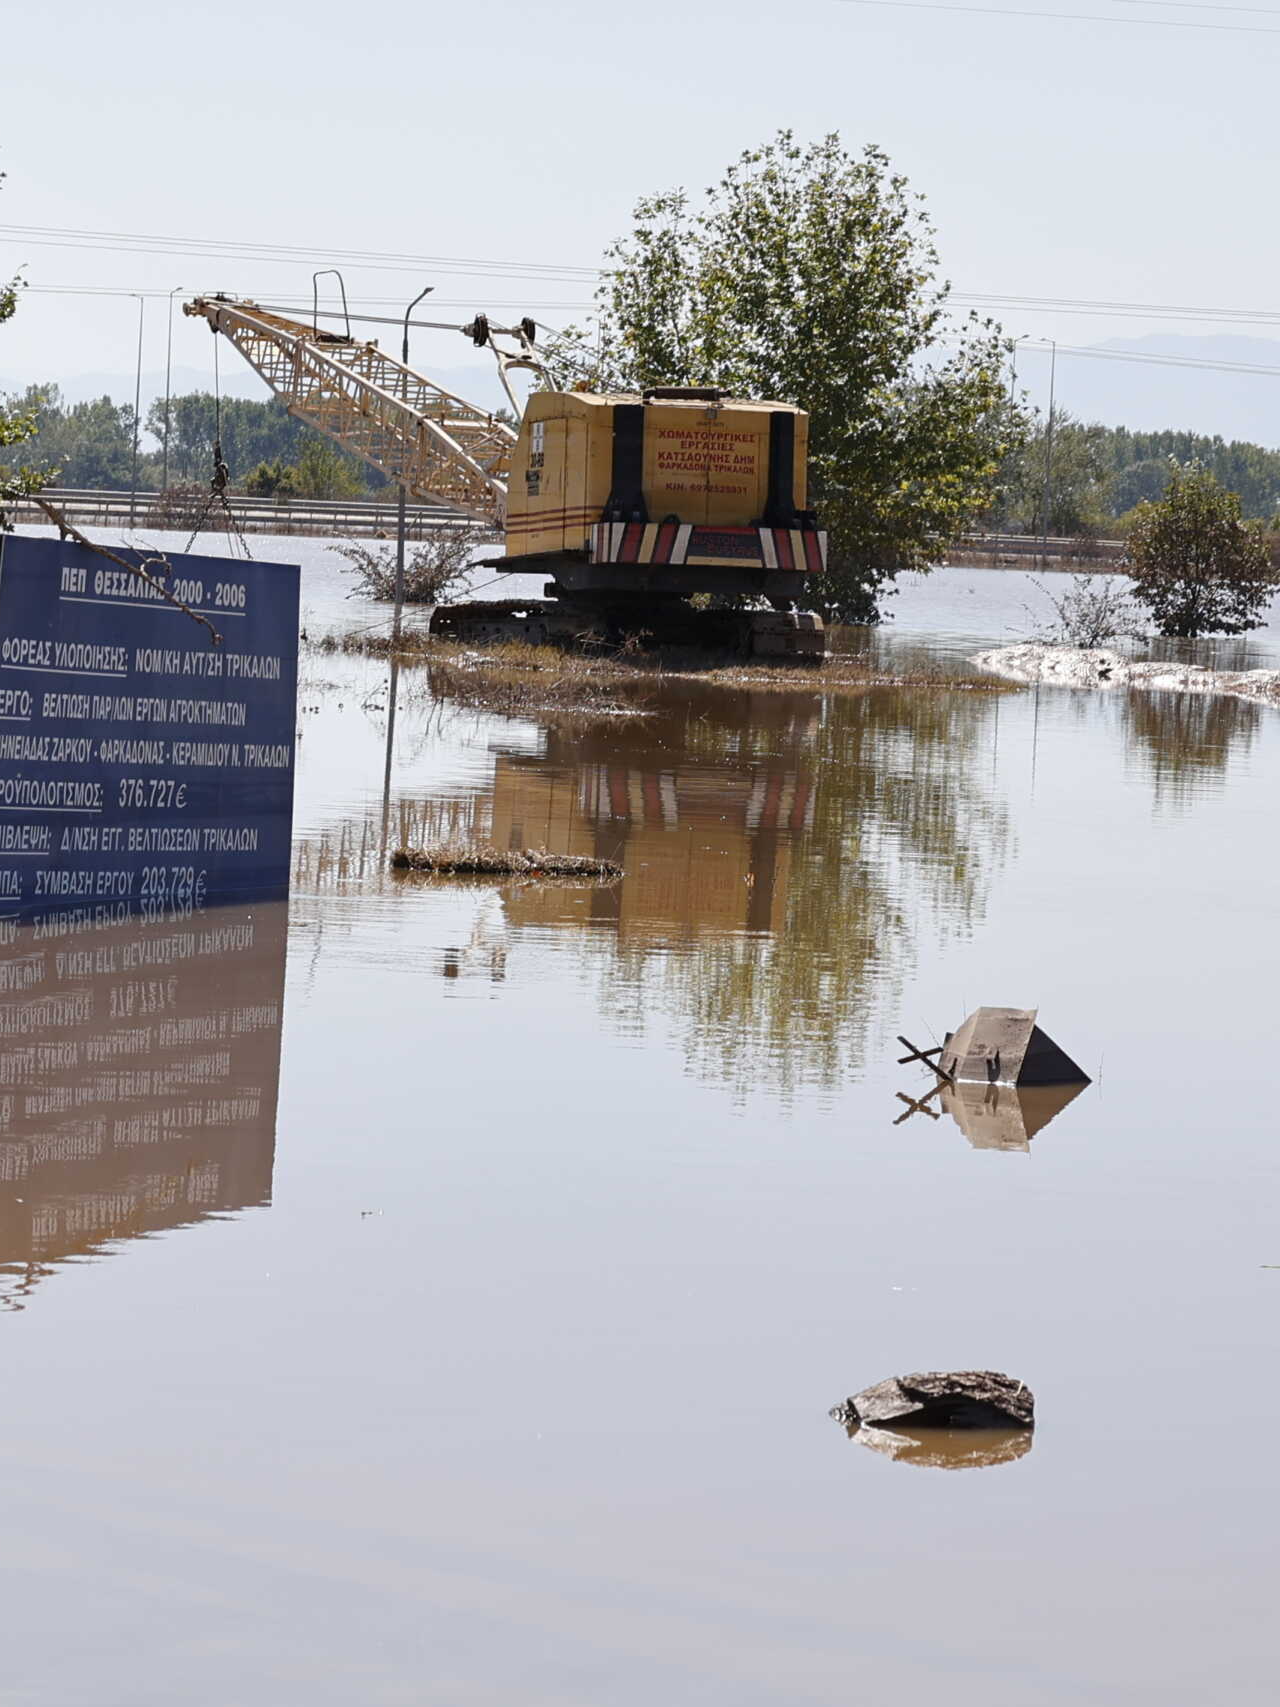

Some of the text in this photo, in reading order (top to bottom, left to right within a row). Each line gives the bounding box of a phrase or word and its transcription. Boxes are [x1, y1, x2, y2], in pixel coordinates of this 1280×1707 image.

[658, 430, 755, 443] ΧΩΜΑΤΟΥΡΓΙΚΕΣ
[680, 441, 736, 451] ΕΡΓΑΣΙΕΣ
[657, 451, 731, 463] ΚΑΤΣΑΟΥΝΗΣ
[61, 567, 87, 592] ΠΕΠ
[94, 570, 165, 600] ΘΕΣΣΑΛΙΑΣ
[173, 578, 202, 604] 2000
[215, 583, 245, 607] 2006
[2, 637, 280, 679] ΦΟΡΕΑΣ ΥΛΟΠΟΙΗΣΗΣ: ΝΟΜ/ΚΗ ΑΥΤ/ΣΗ ΤΡΙΚΑΛΩΝ
[42, 693, 90, 719] ΒΕΛΤΙΩΣΗ
[93, 695, 133, 721] ΠΑΡ/ΛΩΝ
[136, 698, 167, 721] ΕΡΓΩΝ
[169, 700, 245, 725] ΑΓΡΟΚΤΗΜΑΤΩΝ
[51, 737, 92, 762] ΖΑΡΚΟΥ
[100, 740, 164, 764] ΦΑΡΚΑΔΟΝΑΣ
[172, 742, 230, 766] ΚΕΡΑΜΙΔΙΟΥ
[231, 745, 241, 766] Ν.
[244, 745, 289, 768] ΤΡΙΚΑΛΩΝ
[61, 826, 98, 851] Δ/ΝΣΗ
[101, 828, 124, 850] ΕΓΓ.
[128, 828, 200, 851] ΒΕΛΤΙΩΣΕΩΝ
[203, 829, 258, 851] ΤΡΙΚΑΛΩΝ
[35, 871, 93, 895] ΣΥΜΒΑΣΗ
[96, 872, 134, 895] ΕΡΓΟΥ
